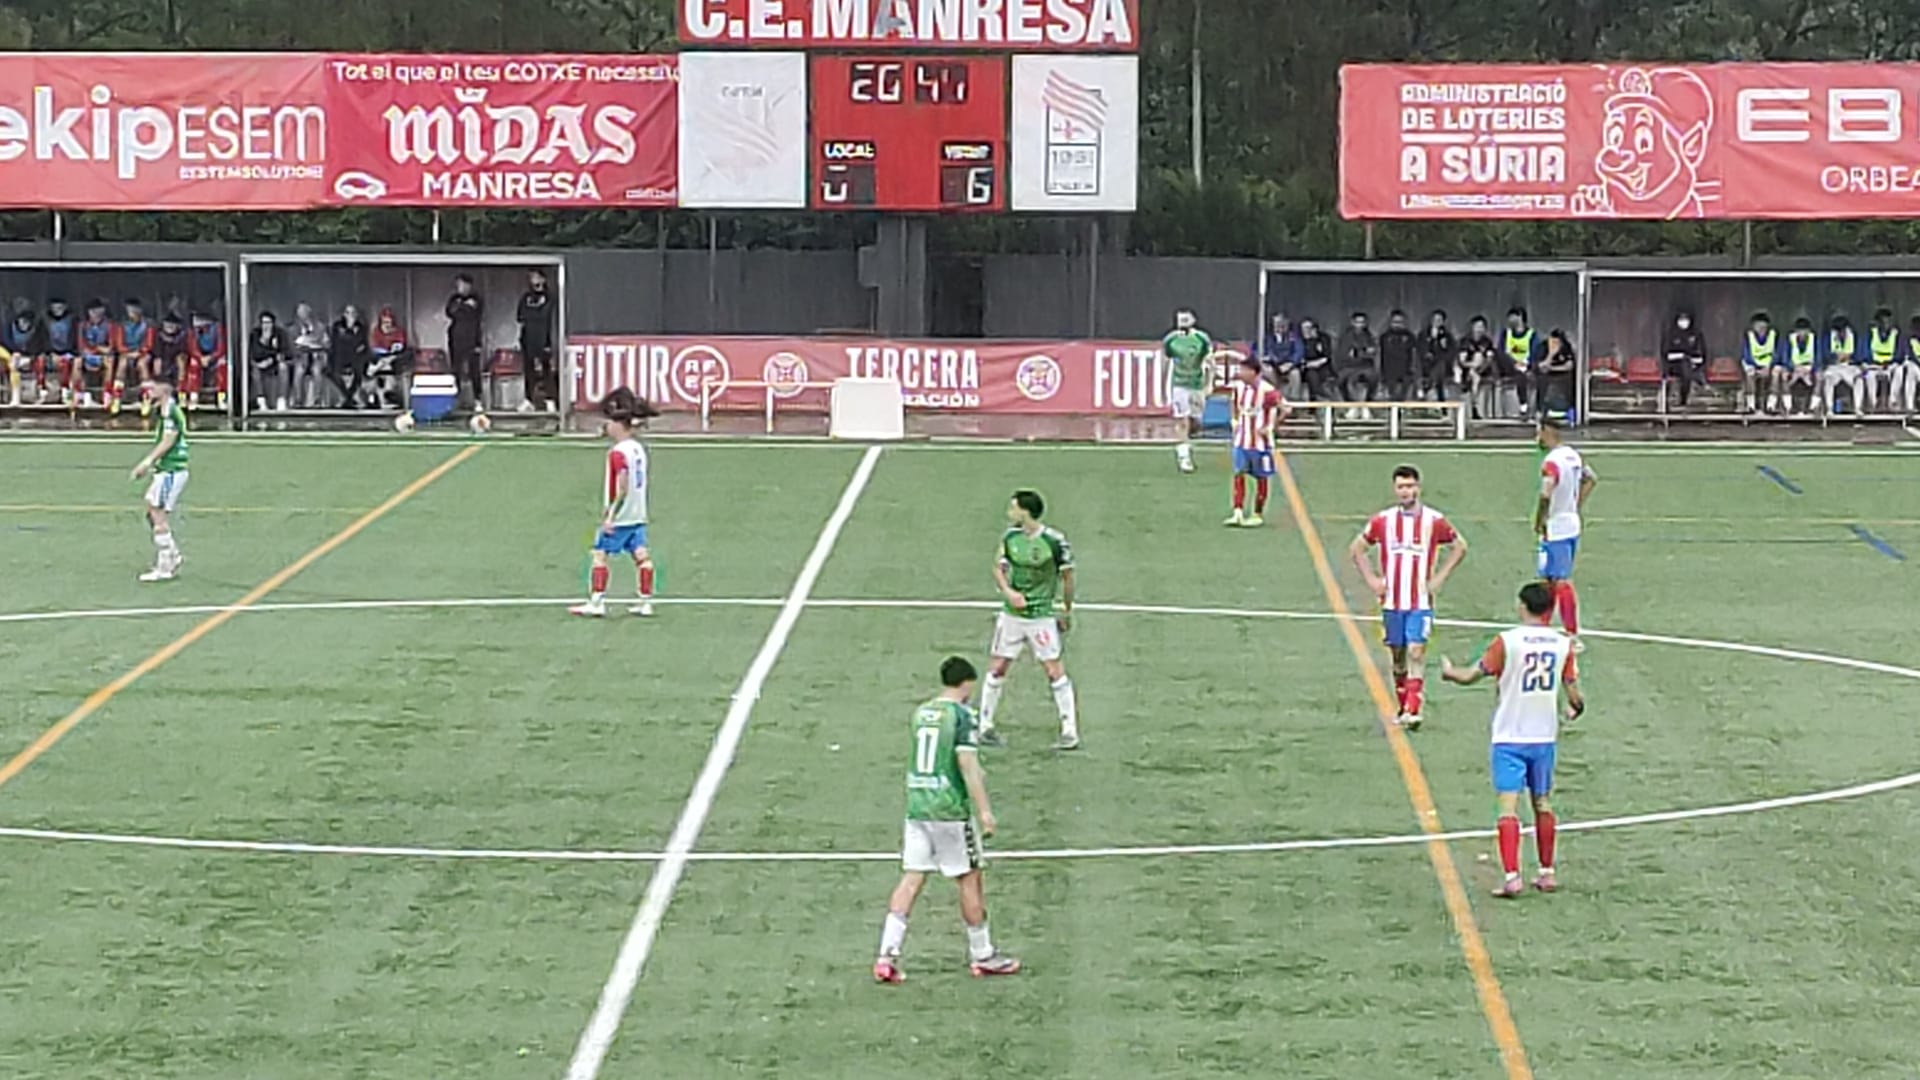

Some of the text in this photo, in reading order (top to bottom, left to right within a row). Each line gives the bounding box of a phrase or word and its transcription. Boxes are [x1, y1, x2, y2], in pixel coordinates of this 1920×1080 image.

[685, 0, 1133, 43] C.E. MANRESA
[332, 61, 368, 82] Tot
[395, 65, 436, 85] que
[504, 62, 586, 82] COTXE
[1402, 78, 1566, 103] ADMINISTRACIÓ
[0, 84, 325, 179] ekip ESEM
[1402, 108, 1565, 130] DE LOTERIES
[1737, 88, 1920, 141] EB
[1401, 134, 1565, 183] A SÚRIA
[423, 171, 601, 200] MANRESA
[846, 347, 979, 389] TERCERA
[1522, 652, 1556, 692] 23
